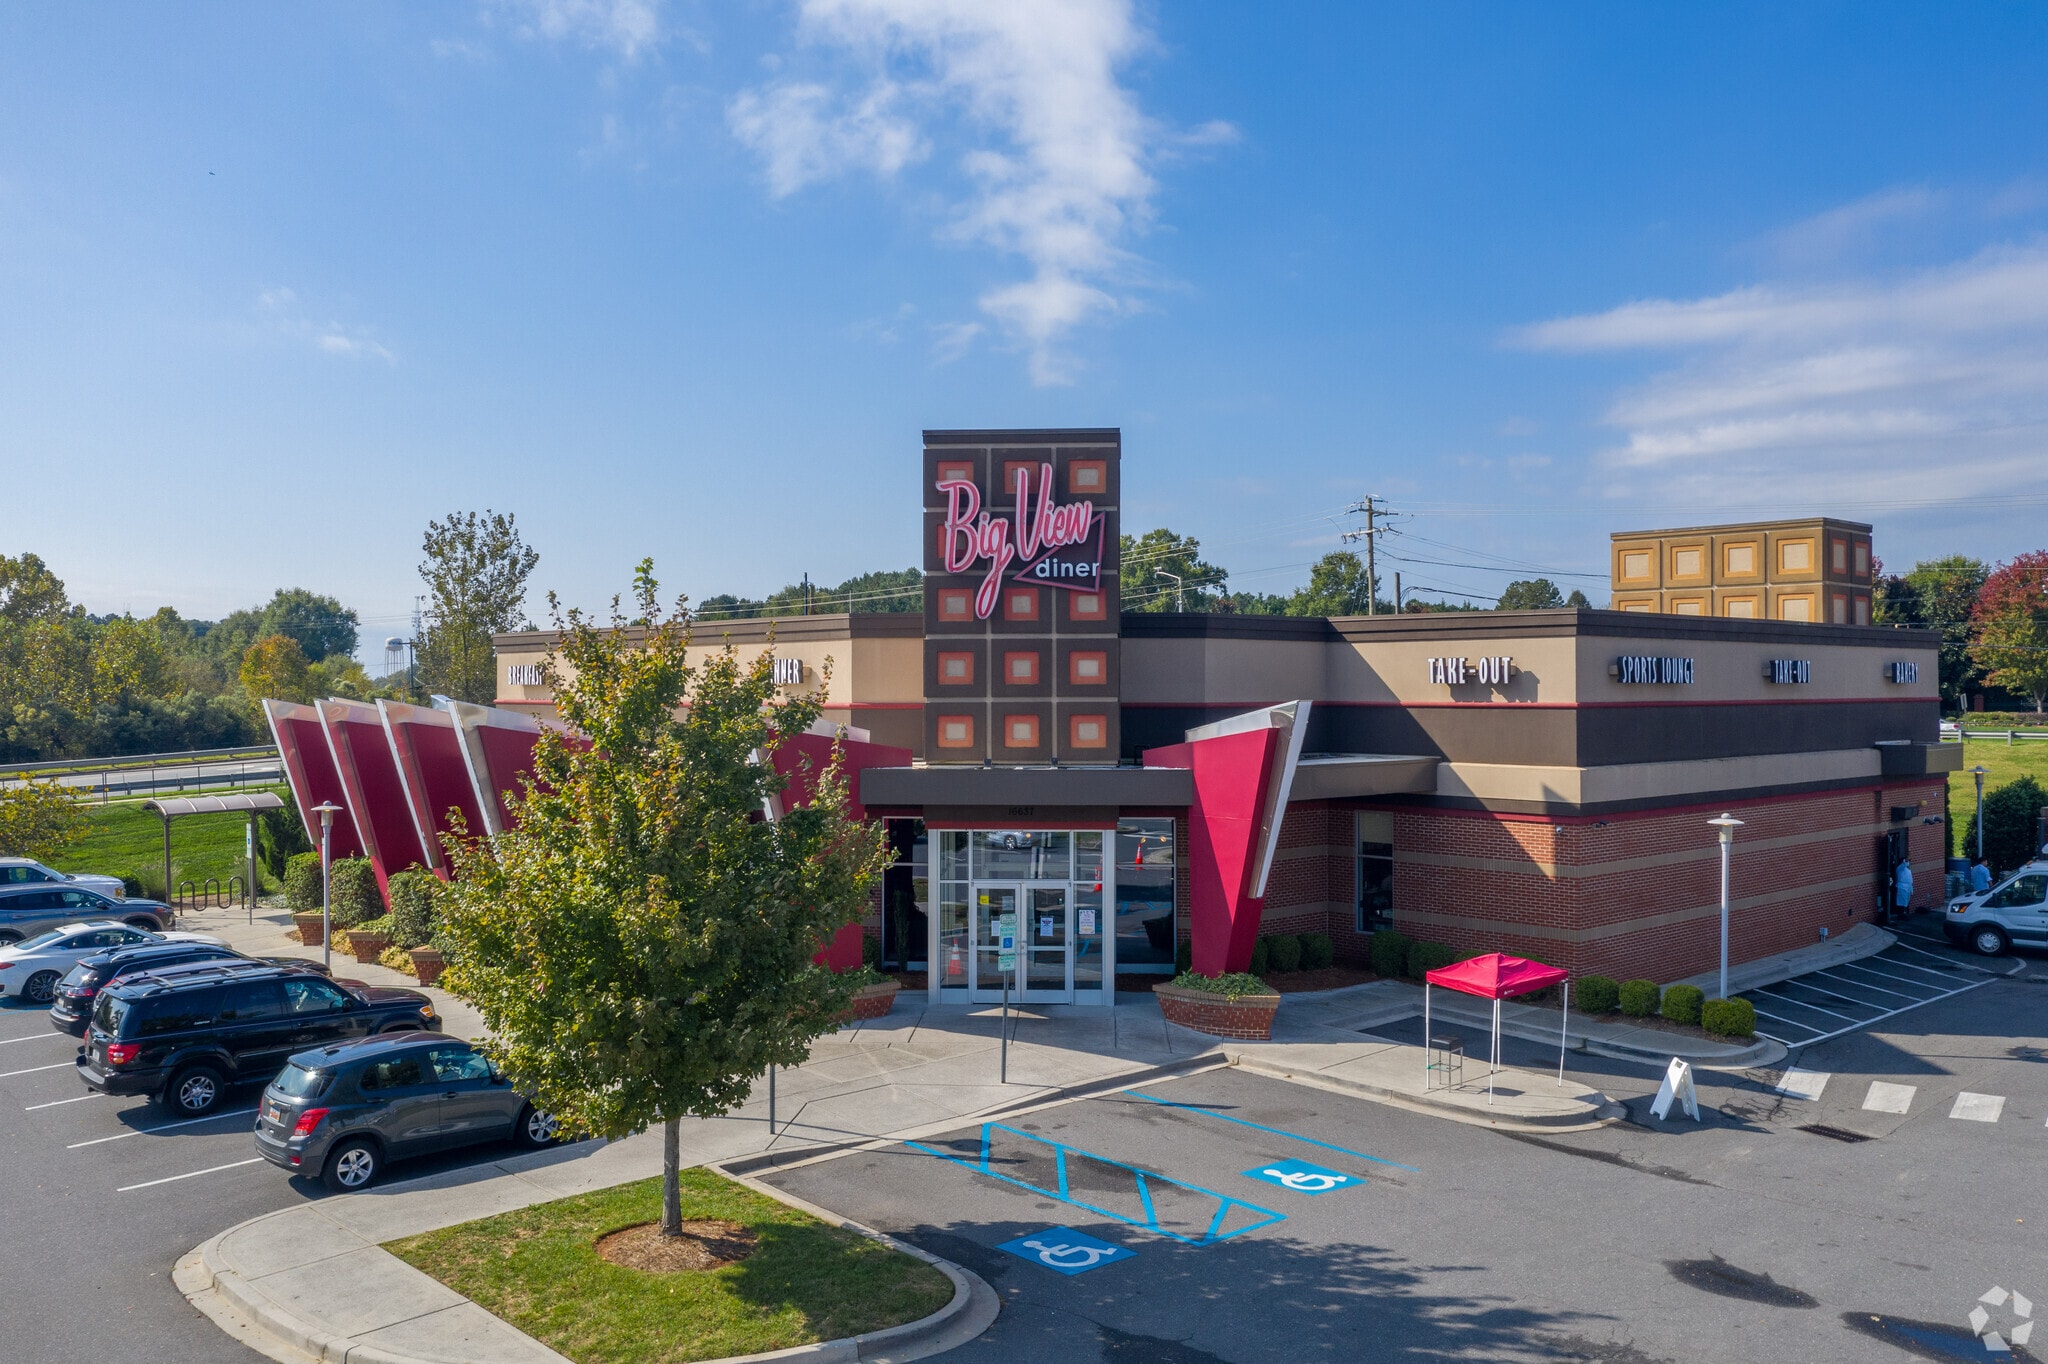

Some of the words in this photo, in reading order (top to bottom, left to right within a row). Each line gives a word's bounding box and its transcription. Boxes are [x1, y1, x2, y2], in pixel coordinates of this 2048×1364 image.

[936, 479, 1014, 619] Big
[1015, 462, 1093, 561] View
[1035, 558, 1099, 577] diner
[770, 659, 800, 684] NNER
[1427, 657, 1511, 684] TAKE-OUT
[1622, 655, 1657, 684] SPORTS
[1662, 657, 1694, 684] LOUNGE
[1896, 662, 1919, 684] BAKERY
